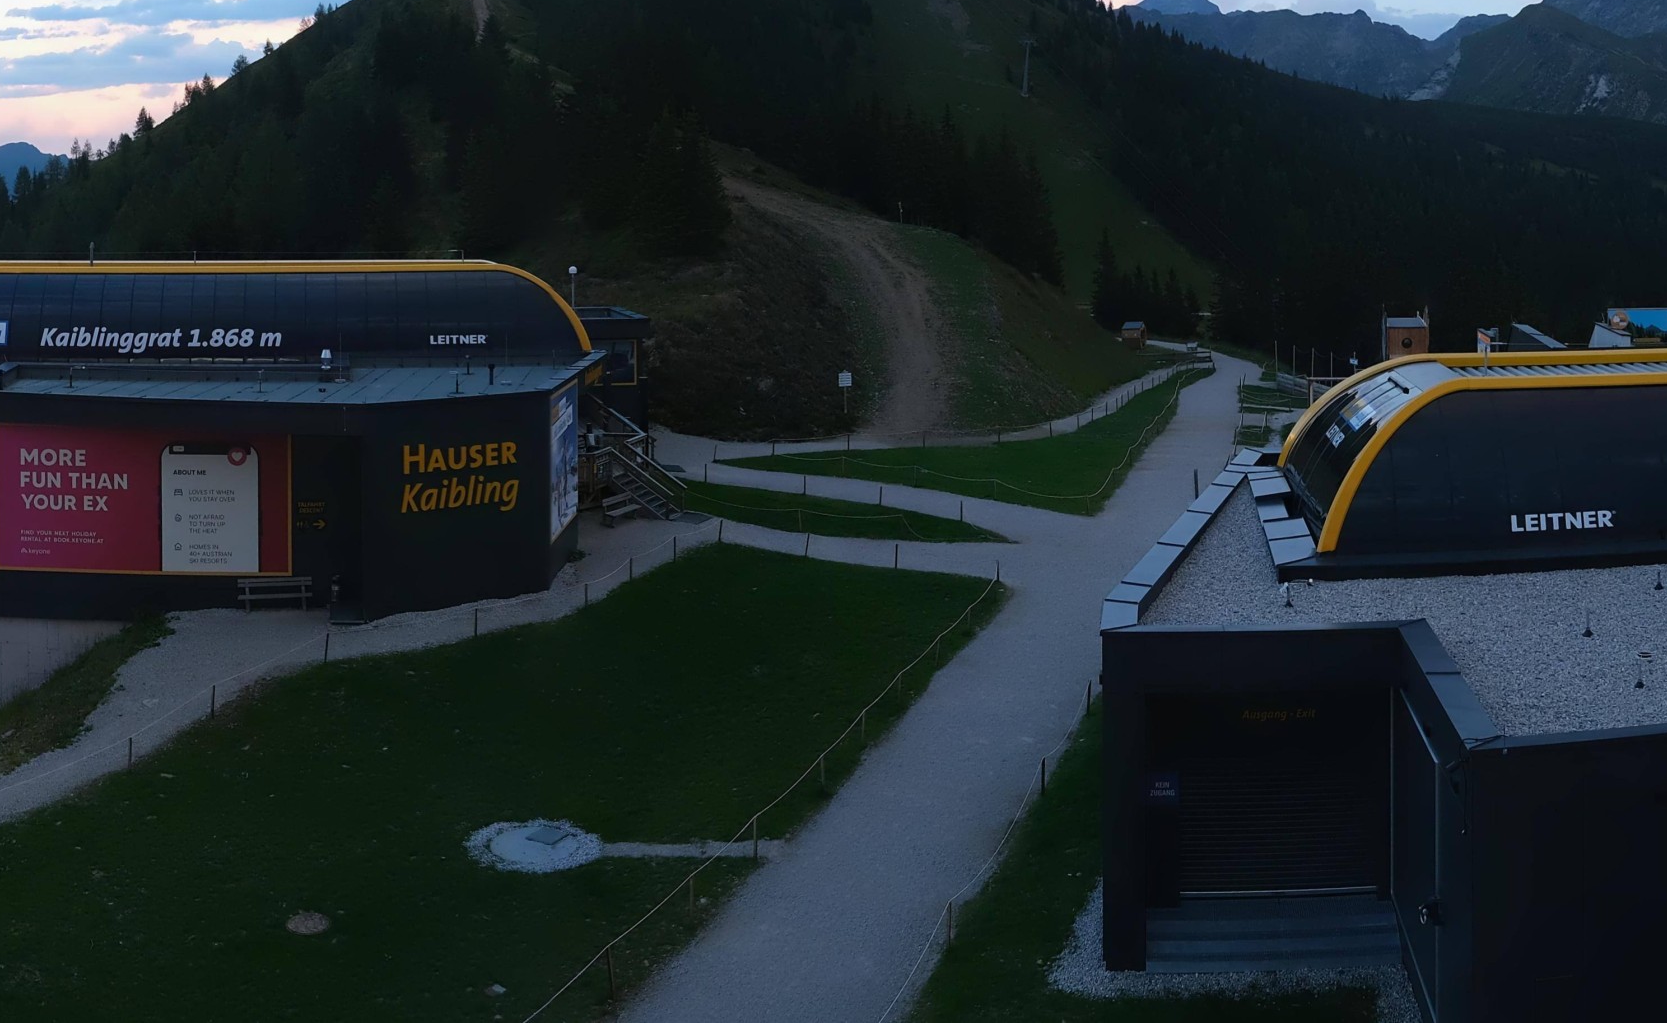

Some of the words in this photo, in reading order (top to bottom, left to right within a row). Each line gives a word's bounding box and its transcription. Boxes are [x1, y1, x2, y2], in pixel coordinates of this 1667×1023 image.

[40, 327, 182, 353] Kaiblinggrat
[186, 328, 255, 348] 1.868
[260, 332, 282, 348] m
[429, 334, 488, 345] LEITNER
[20, 448, 87, 466] MORE
[402, 441, 518, 475] HAUSER
[20, 471, 61, 488] FUN
[68, 473, 128, 489] THAN
[21, 494, 77, 510] YOUR
[83, 496, 108, 511] EX
[401, 475, 520, 514] Kaibling
[1510, 510, 1615, 532] LEITNER
[1241, 708, 1288, 721] Ausgang
[1296, 708, 1317, 719] Exit
[1150, 789, 1176, 797] ZUGANG
